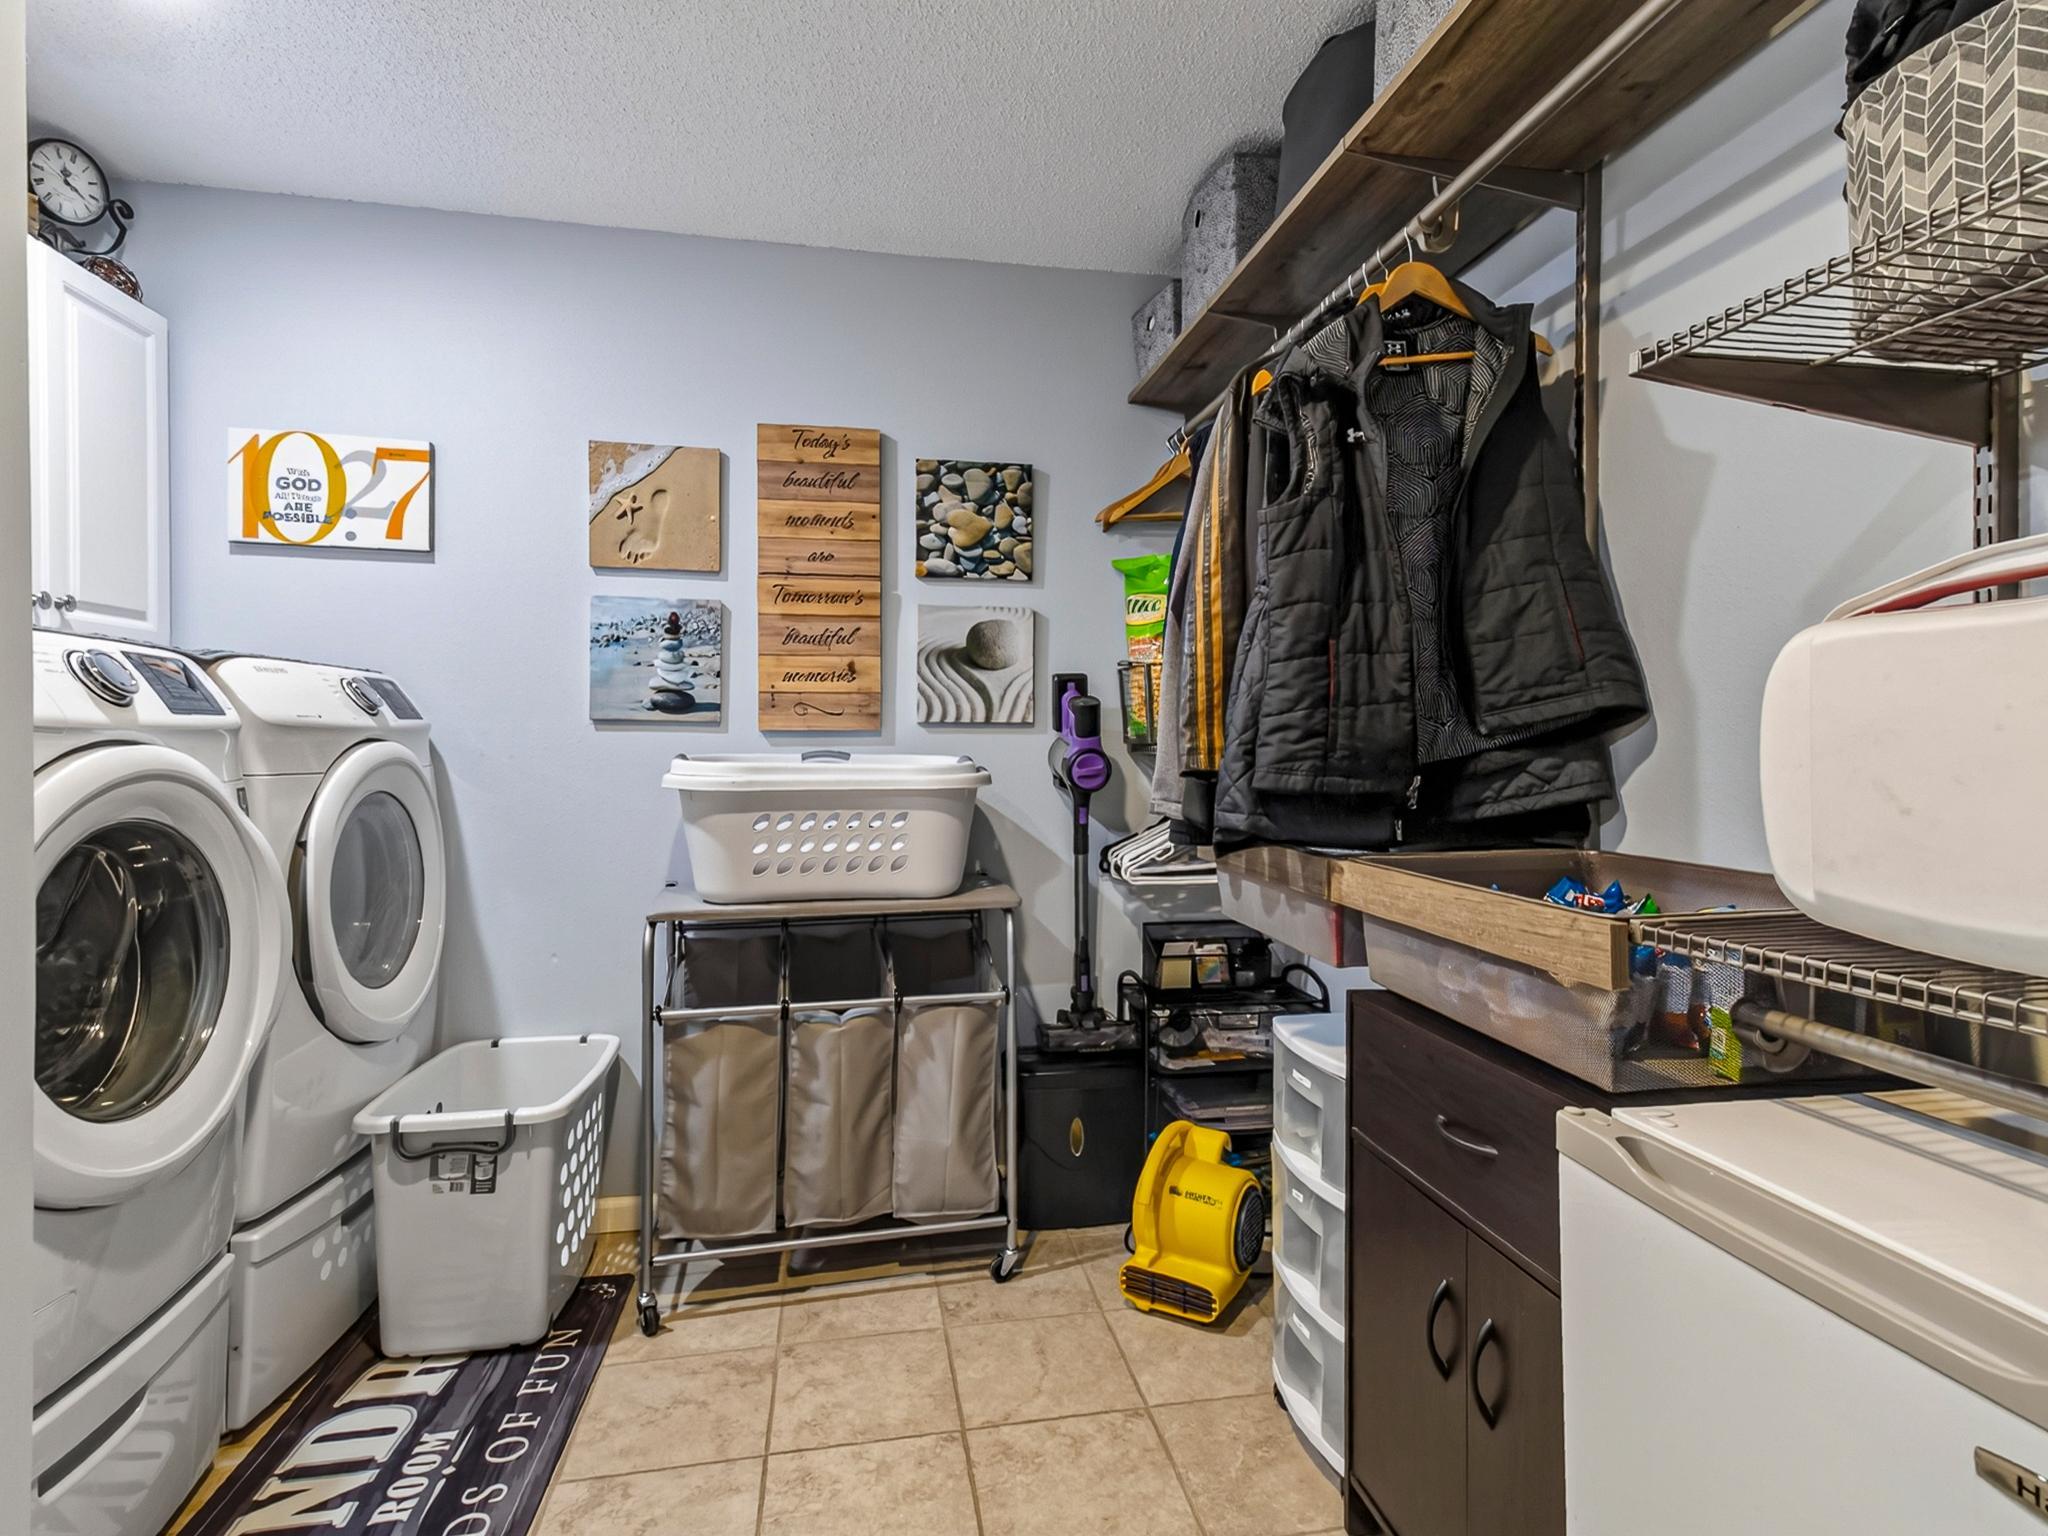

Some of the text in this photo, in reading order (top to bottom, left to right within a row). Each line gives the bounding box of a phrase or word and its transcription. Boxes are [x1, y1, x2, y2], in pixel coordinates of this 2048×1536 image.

[792, 429, 851, 459] Today's
[275, 476, 322, 492] GOD
[782, 470, 860, 494] beautiful
[262, 510, 335, 525] POSSIBLE
[284, 502, 313, 513] ARE
[784, 511, 854, 530] moments
[807, 551, 834, 563] are
[772, 584, 864, 606] Tomorrow's
[782, 626, 862, 651] beautiful
[782, 667, 856, 683] memories
[485, 1412, 541, 1463] OF
[516, 1329, 582, 1397] FUN
[366, 1430, 460, 1526] ROOM
[2017, 1474, 2048, 1513] H
